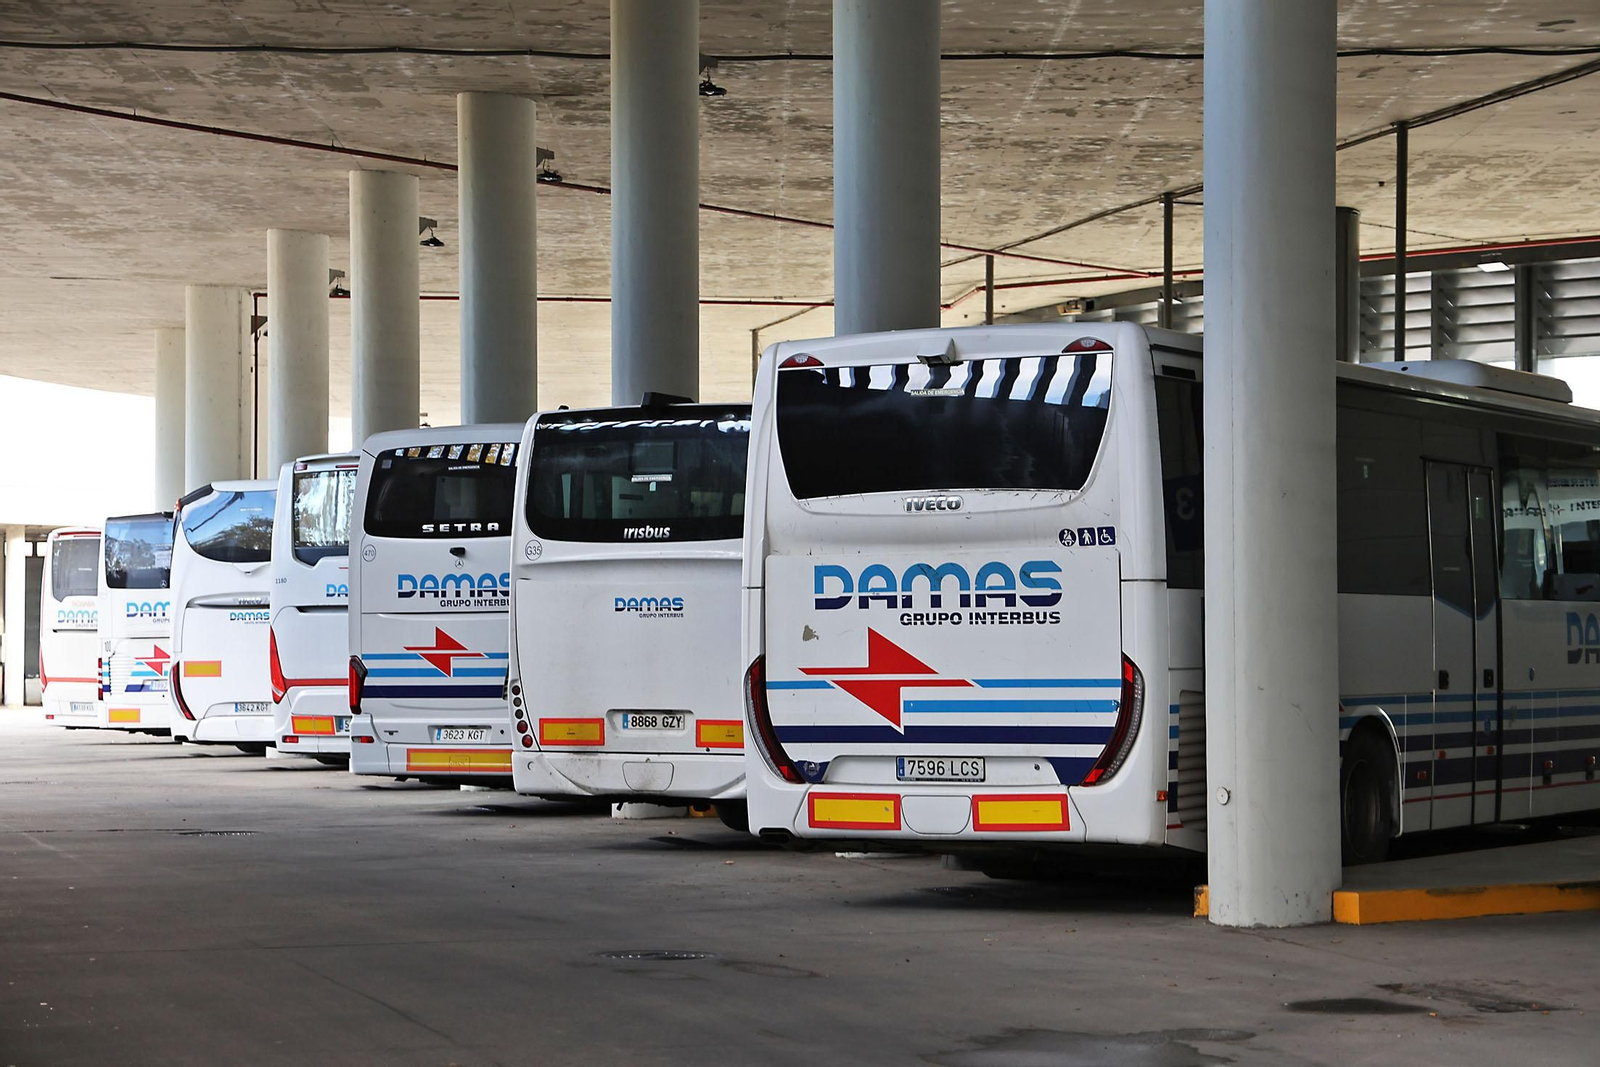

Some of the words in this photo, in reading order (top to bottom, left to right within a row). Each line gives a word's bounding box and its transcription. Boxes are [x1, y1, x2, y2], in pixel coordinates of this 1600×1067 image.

[906, 497, 962, 511] IVECO
[422, 523, 499, 533] SETRA
[623, 525, 671, 539] irisbus
[526, 545, 541, 556] G35
[814, 560, 1062, 610] DAMAS
[614, 597, 684, 612] DAMAS
[230, 611, 270, 621] DAMAS
[900, 611, 962, 626] GRUPO
[969, 611, 1061, 626] INTERBUS
[631, 716, 657, 728] 8868
[662, 716, 682, 728] GZY
[443, 729, 464, 740] 3623
[467, 729, 484, 740] KGT
[907, 760, 946, 776] 7596
[950, 760, 979, 776] LCS
